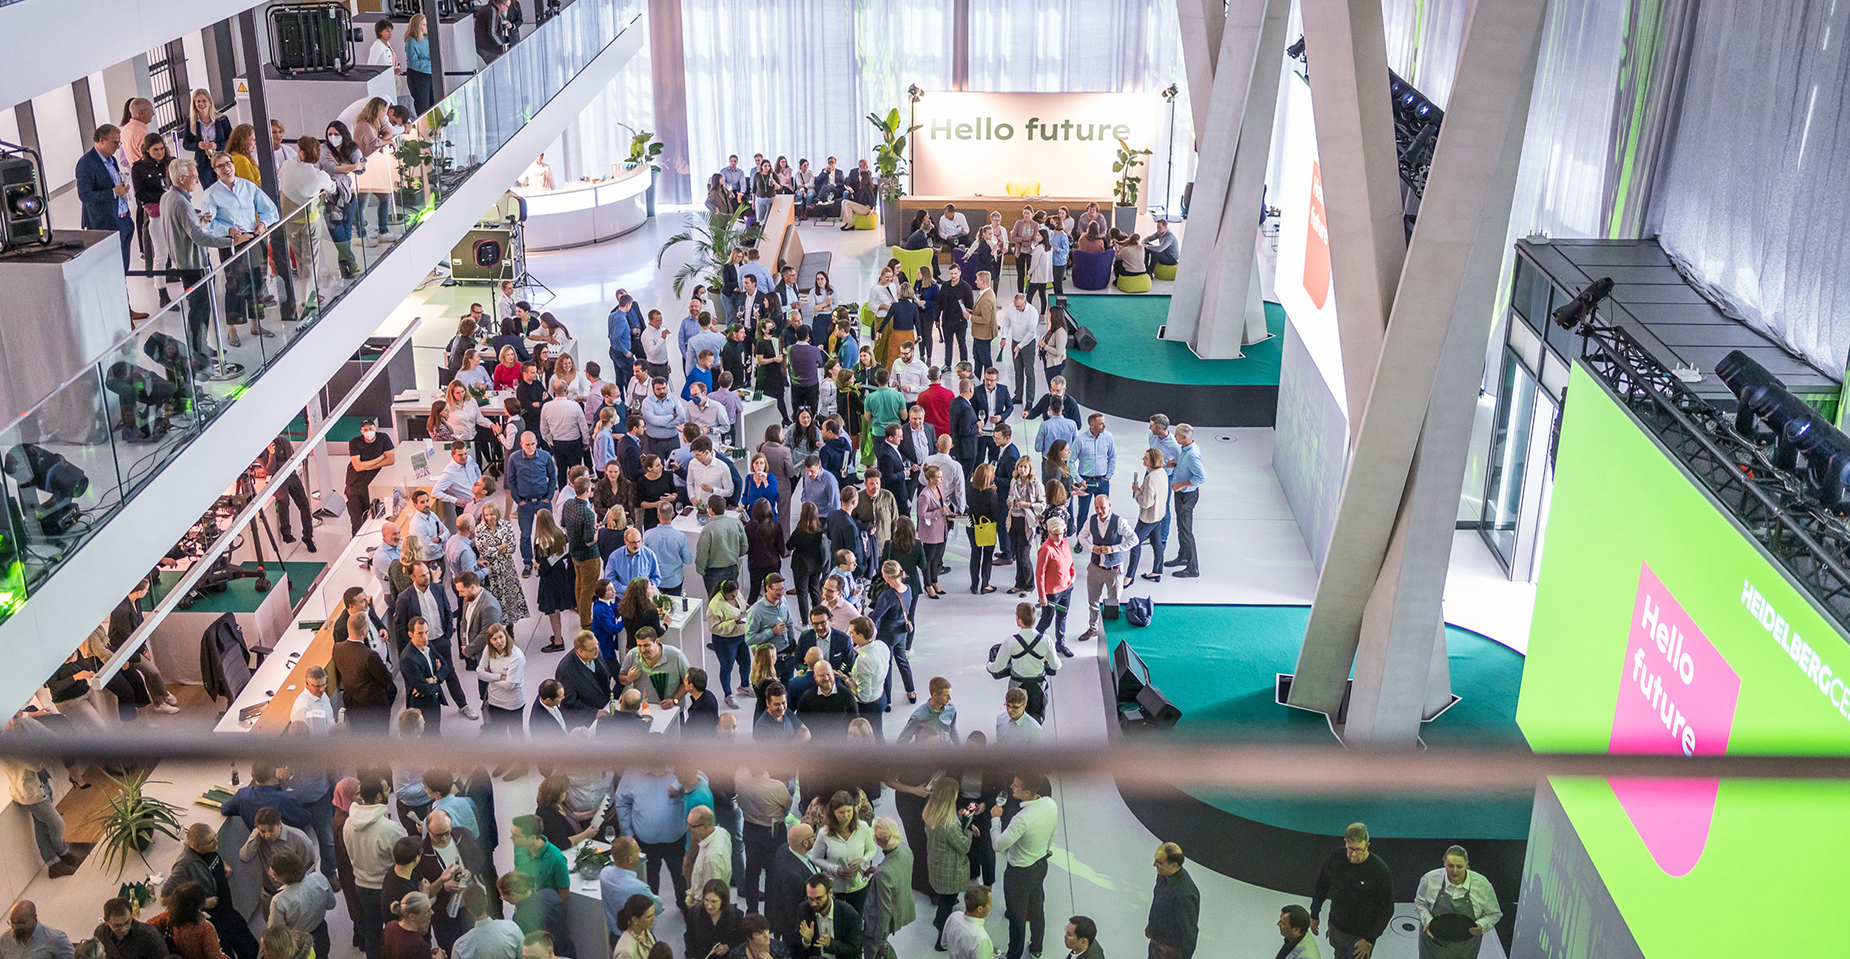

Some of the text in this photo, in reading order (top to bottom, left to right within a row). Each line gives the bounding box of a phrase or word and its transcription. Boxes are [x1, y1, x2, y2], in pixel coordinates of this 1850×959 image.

[931, 117, 1131, 141] Hello future
[1310, 205, 1329, 245] future
[1641, 593, 1694, 685] Hello
[1740, 578, 1850, 721] HEIDELBERGCE
[1632, 648, 1696, 757] future
